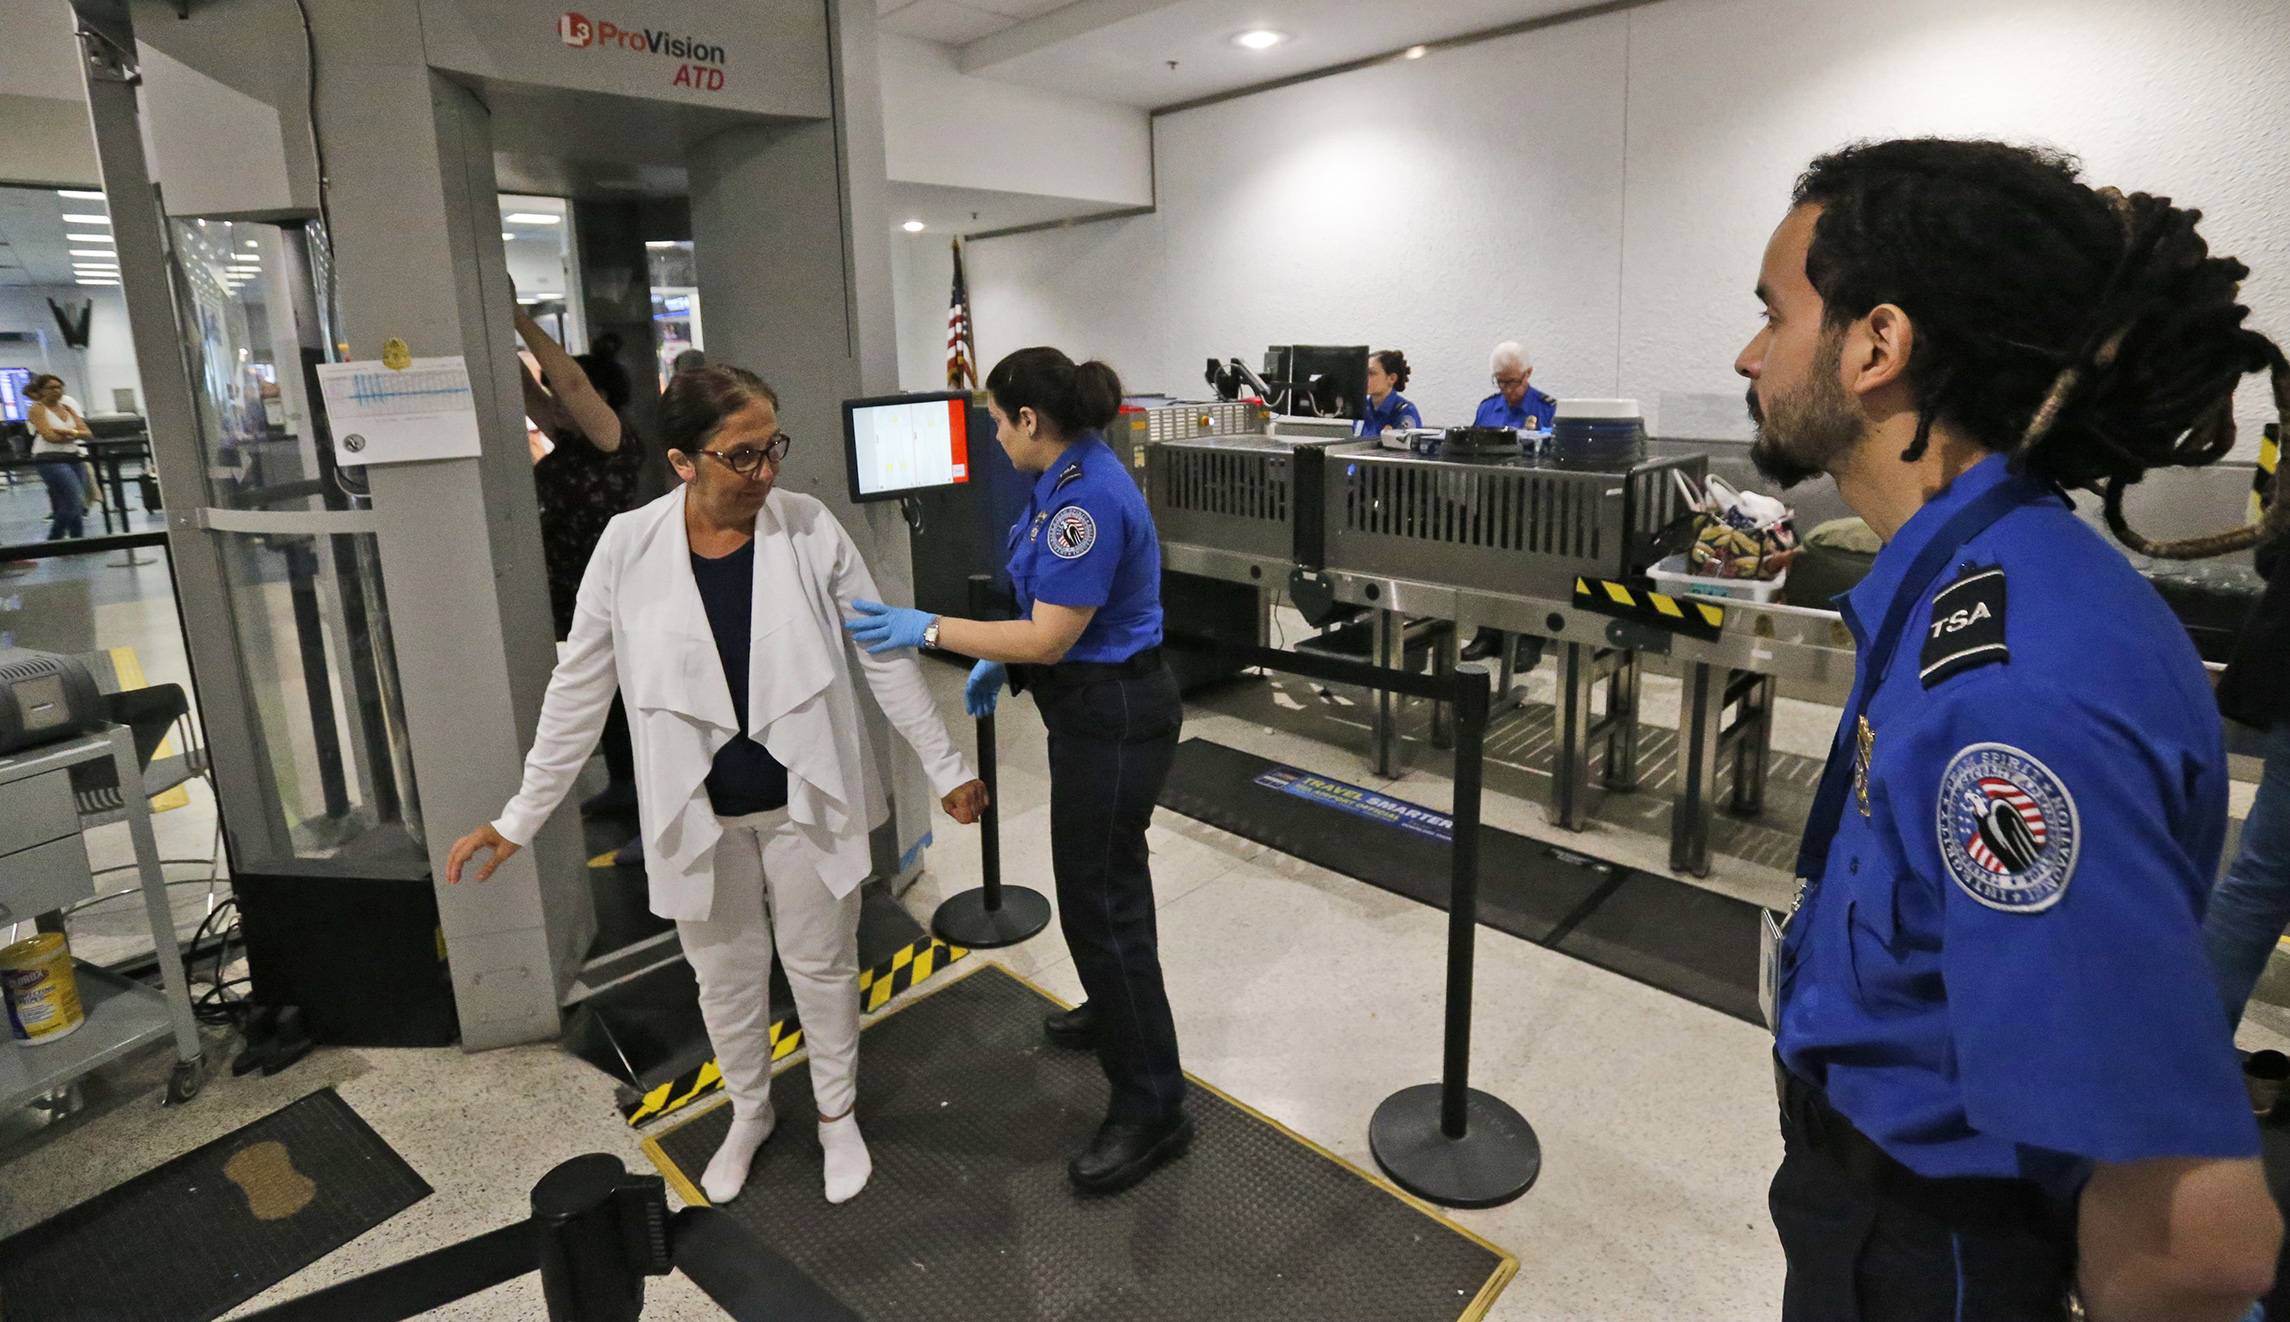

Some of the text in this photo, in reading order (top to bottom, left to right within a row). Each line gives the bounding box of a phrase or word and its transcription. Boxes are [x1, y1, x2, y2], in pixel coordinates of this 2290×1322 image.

[561, 14, 726, 64] L3 ProVision
[672, 63, 725, 92] ATD
[1930, 601, 1992, 638] TSA
[1981, 752, 2045, 783] SPIRIT
[1303, 777, 1363, 800] TRAVEL
[1366, 797, 1453, 829] SMARTER
[1941, 811, 2009, 902] INTEGRITY
